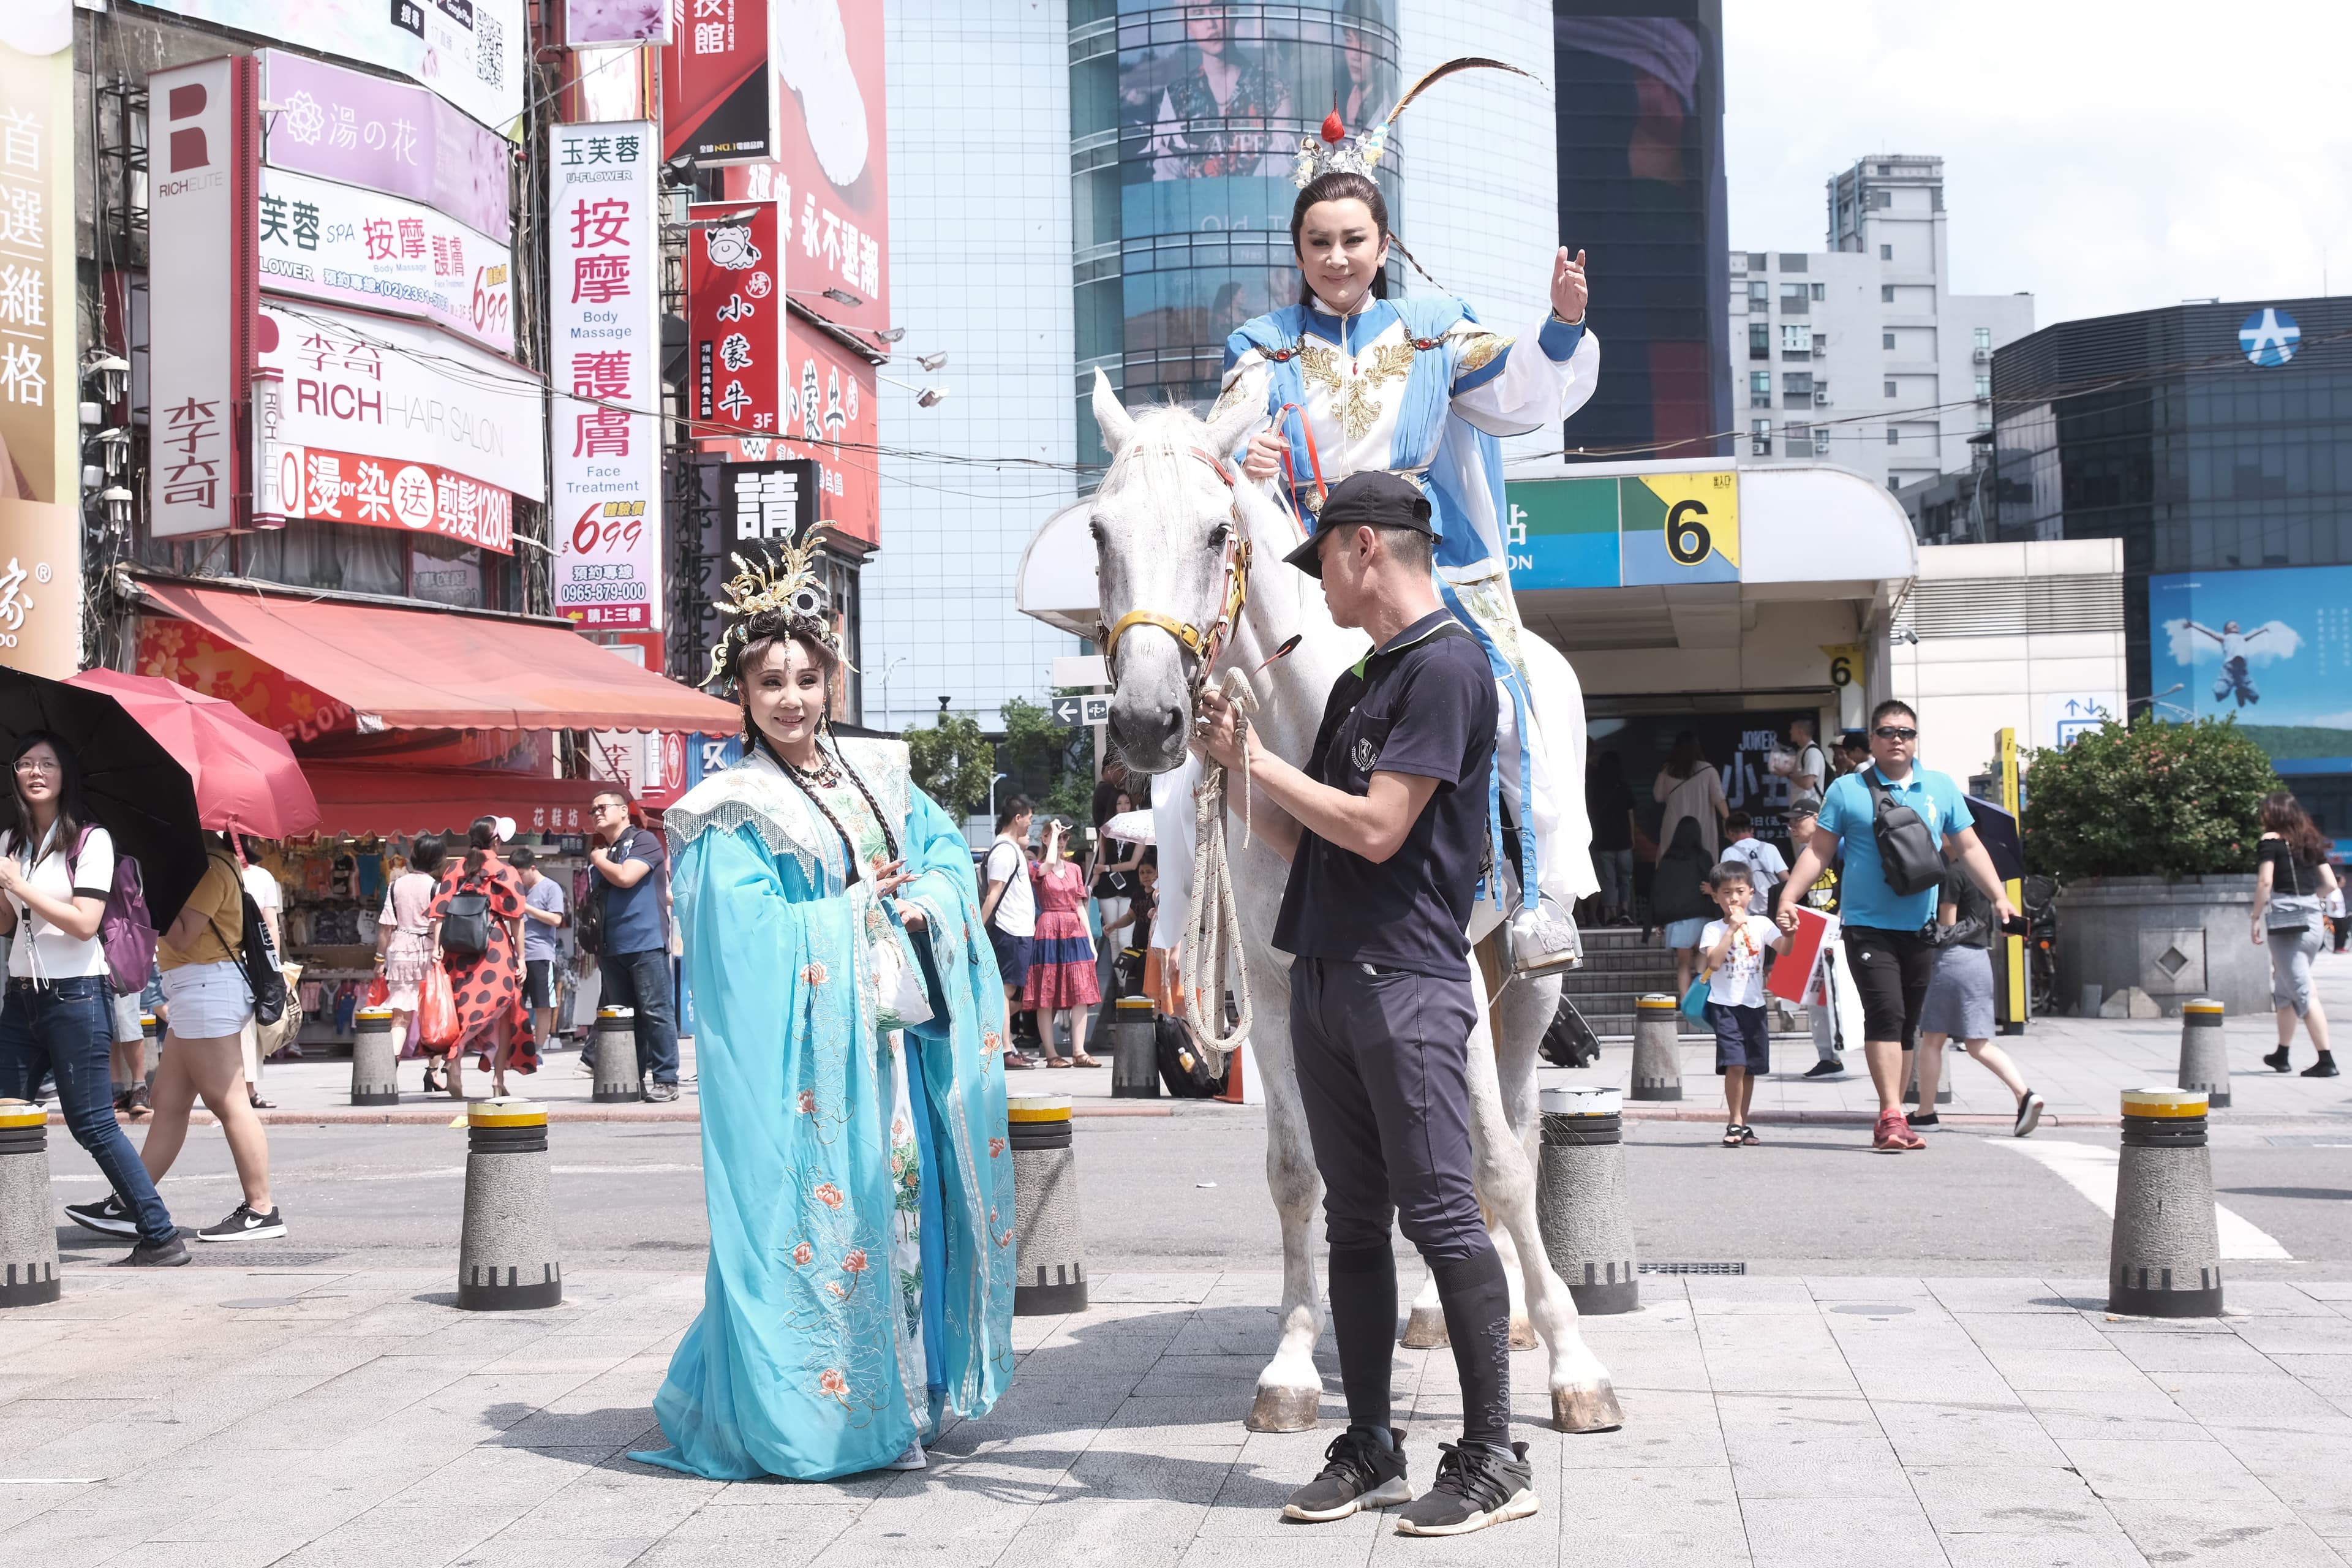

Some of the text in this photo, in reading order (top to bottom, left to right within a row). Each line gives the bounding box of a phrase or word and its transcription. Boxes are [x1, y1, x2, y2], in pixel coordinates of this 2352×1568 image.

[328, 102, 418, 167] 湯の花
[560, 135, 639, 166] 玉芙蓉
[567, 170, 633, 183] U-FLOWER
[259, 192, 320, 251] 芙蓉
[326, 224, 356, 244] SPA
[363, 216, 427, 261] 按摩
[570, 197, 630, 304] 按摩
[801, 191, 879, 300] 永不退潮
[373, 262, 427, 274] Body Massage
[432, 235, 464, 277] 護膚
[748, 273, 768, 295] 烤
[570, 326, 632, 339] Massage
[583, 311, 618, 324] Body
[296, 333, 384, 382] 李奇
[716, 293, 755, 421] 小蒙牛
[297, 378, 503, 458] RICH HAIR SALON
[571, 350, 631, 458] 護膚
[752, 412, 774, 429] 3F
[164, 397, 221, 510] 李奇
[567, 480, 639, 493] Treatment
[587, 466, 620, 478] Face
[1713, 475, 1732, 486] 出入口
[734, 470, 799, 540] 請
[1667, 499, 1712, 564] 6
[573, 564, 634, 581] 預約專線
[561, 582, 646, 603] 0965-879-000
[1831, 656, 1851, 687] 6
[1738, 730, 1778, 751] JOKER
[533, 807, 578, 827] 花鞋坊
